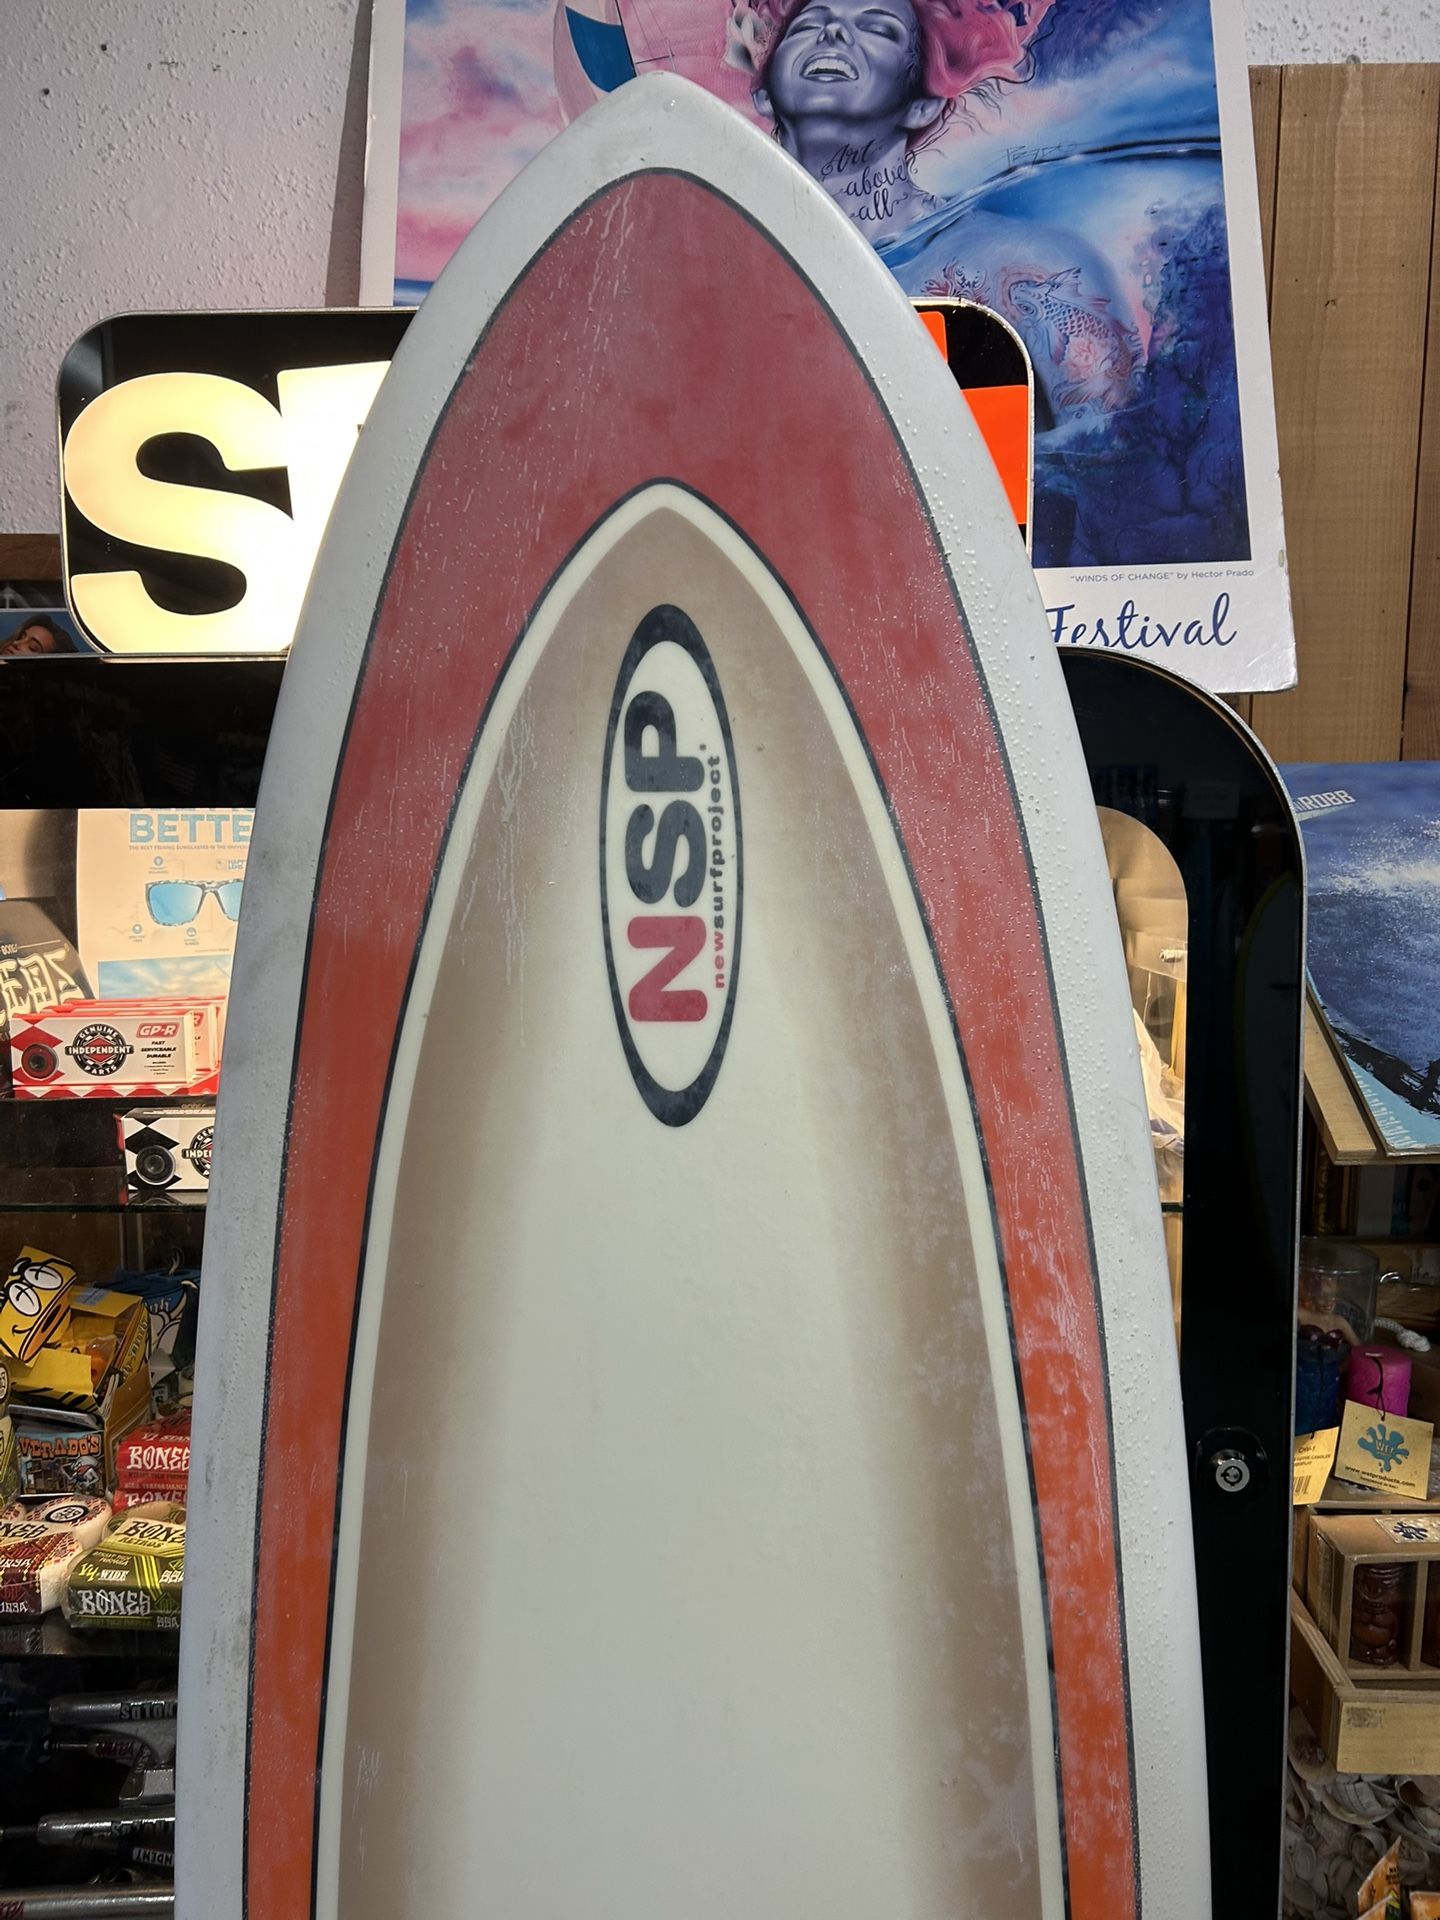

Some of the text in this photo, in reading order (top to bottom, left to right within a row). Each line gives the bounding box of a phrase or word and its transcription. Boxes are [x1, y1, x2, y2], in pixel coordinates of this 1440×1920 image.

[821, 139, 876, 182] Art
[843, 163, 907, 197] above
[854, 187, 904, 221] all
[1110, 573, 1125, 582] OF
[1176, 571, 1188, 580] by
[1191, 570, 1224, 579] Hector
[1225, 569, 1255, 577] Prado
[1045, 592, 1238, 650] Festival
[624, 690, 708, 1022] NSP
[79, 1025, 118, 1039] GENUINE
[68, 1046, 132, 1055] INDEPENDENT
[84, 1065, 118, 1076] PARTS
[77, 1588, 151, 1616] BONES
